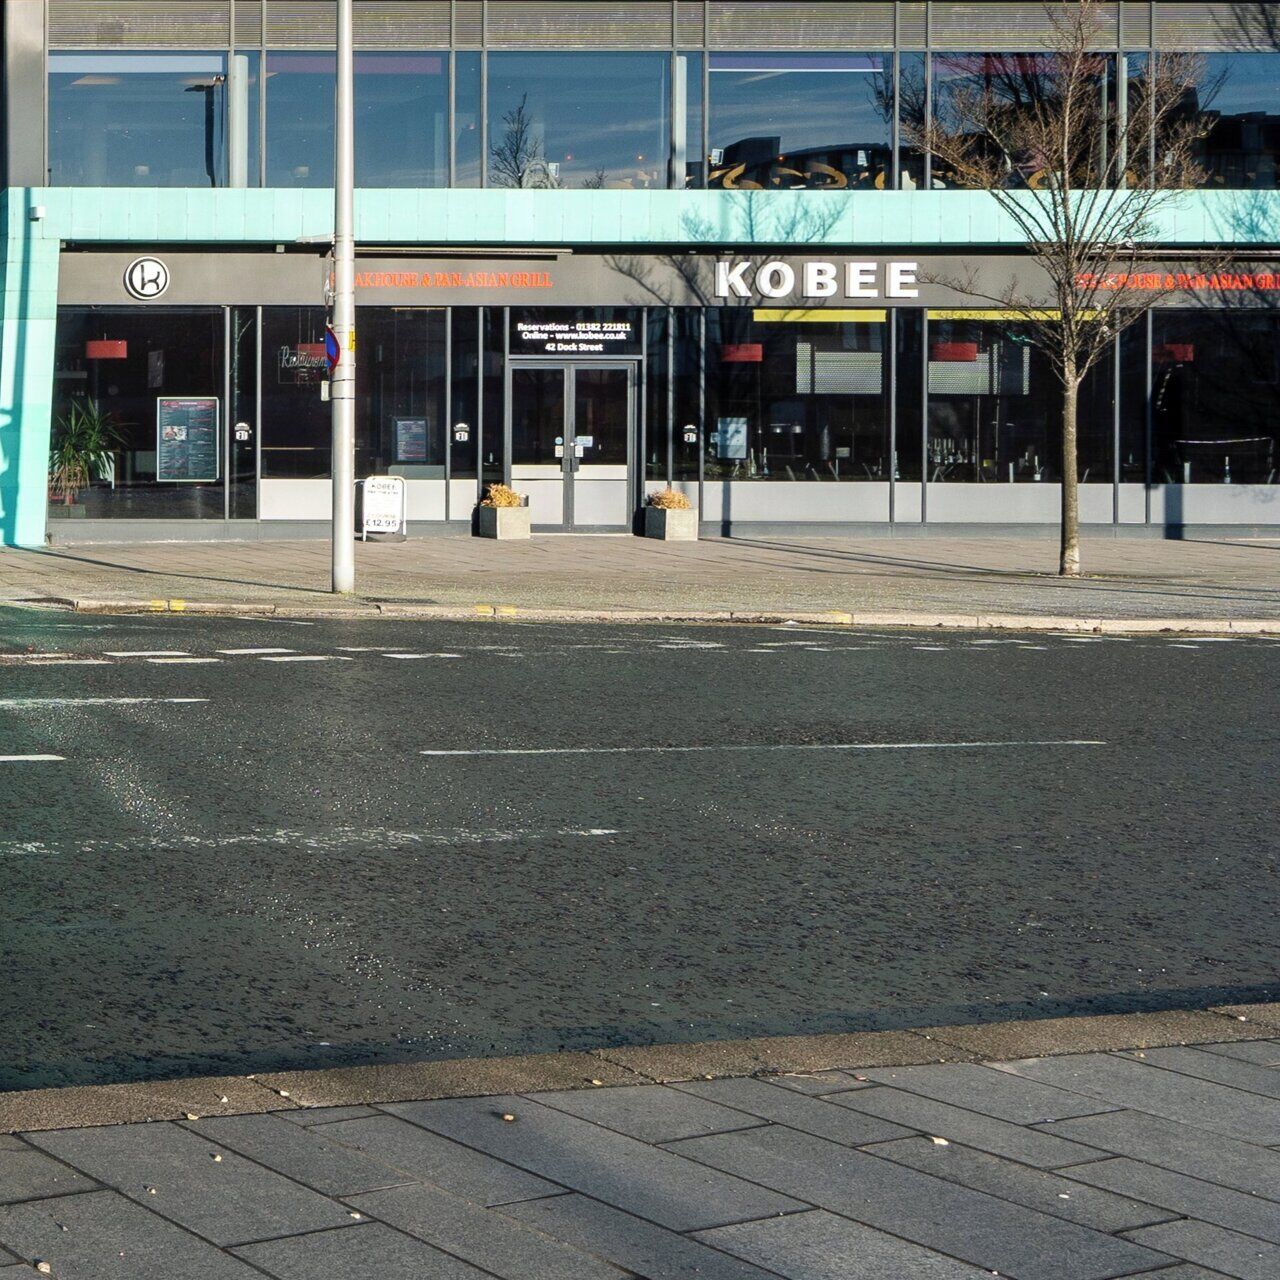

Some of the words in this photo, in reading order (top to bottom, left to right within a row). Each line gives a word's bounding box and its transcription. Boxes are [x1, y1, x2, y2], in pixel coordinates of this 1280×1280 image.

[420, 272, 432, 288] &
[434, 272, 509, 288] PAN-ASIAN
[509, 272, 553, 288] GRILL
[714, 261, 919, 299] KOBEE
[1164, 273, 1175, 290] &
[1176, 273, 1253, 290] PAN-ASIAN
[517, 322, 569, 332] Reservations
[575, 322, 601, 331] 01382
[522, 331, 548, 340] Online
[555, 331, 627, 340] www.kobee.co.uk
[544, 343, 556, 351] 42
[557, 342, 578, 351] Dock
[578, 343, 603, 351] Street
[365, 519, 397, 527] £12.95
